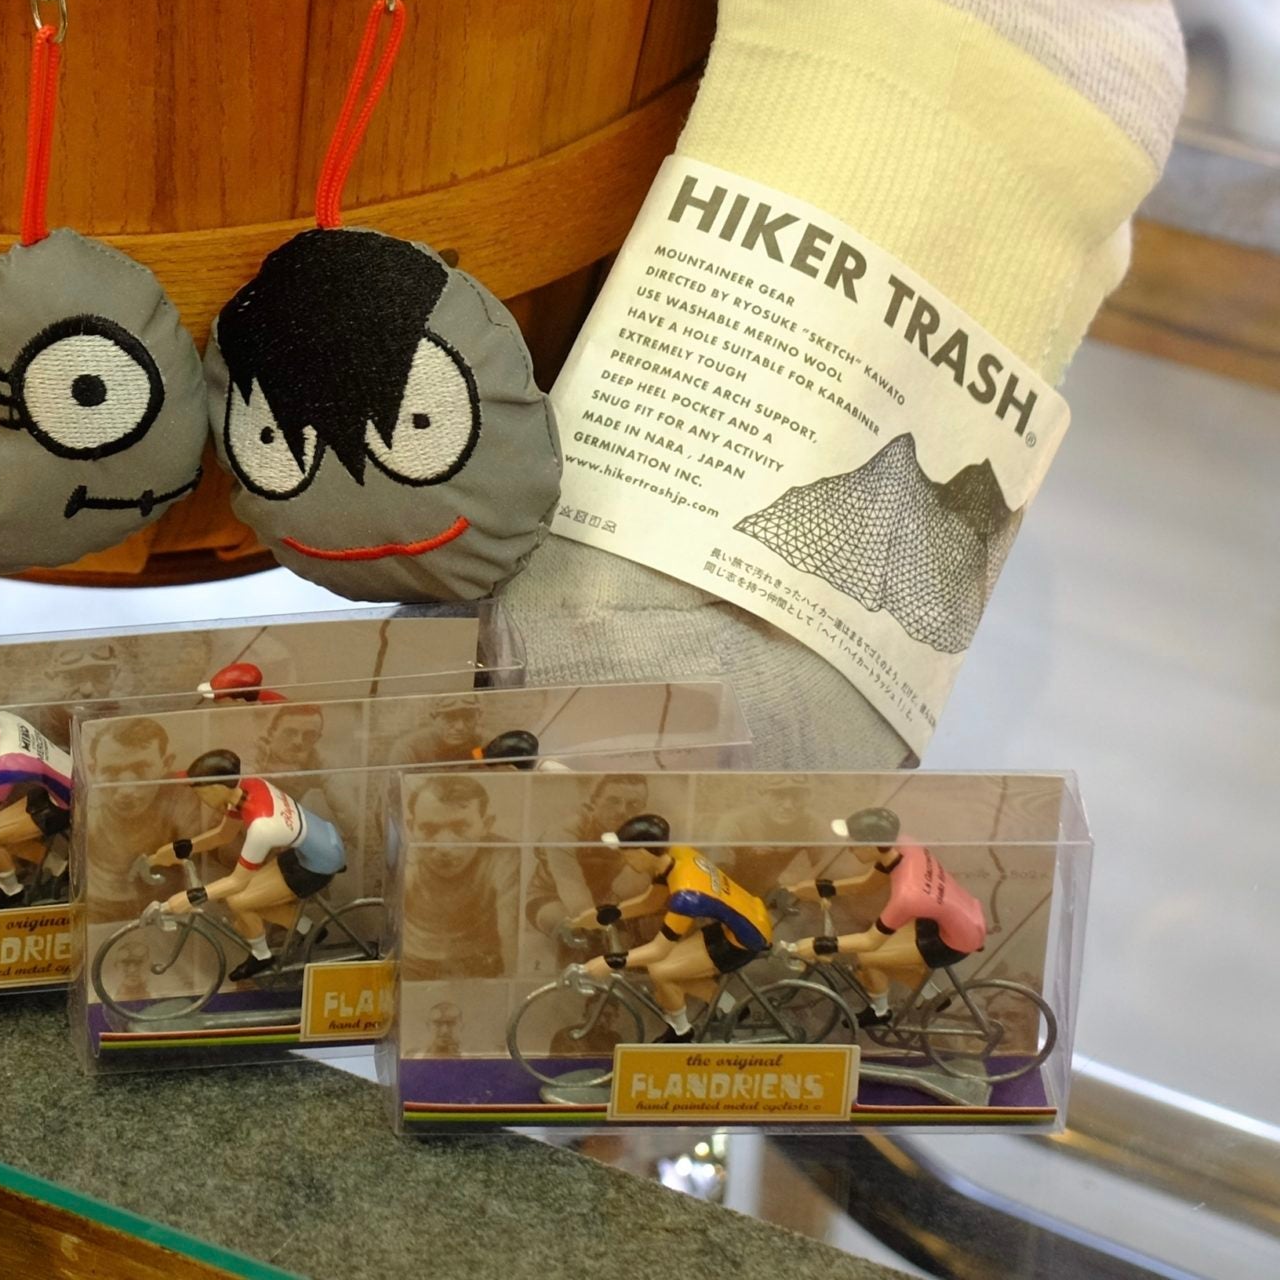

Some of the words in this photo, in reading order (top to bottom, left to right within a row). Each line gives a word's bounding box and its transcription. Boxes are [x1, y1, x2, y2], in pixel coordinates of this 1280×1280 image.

[667, 174, 868, 303] HIKER
[654, 244, 755, 289] MOUNTAINEER
[758, 284, 796, 308] GEAR
[618, 327, 694, 361] EXTREMELY
[697, 354, 748, 383] TOUGH
[636, 285, 662, 302] USE
[666, 295, 741, 331] WASHABLE
[743, 326, 799, 357] MERINO
[803, 353, 843, 383] WOOL
[645, 265, 706, 294] DIRECTED
[710, 288, 730, 302] BY
[732, 296, 798, 333] RYOSUKE
[863, 365, 906, 406] KAWATO
[610, 349, 710, 392] PERFORMANCE
[712, 386, 752, 409] ARCH
[754, 403, 818, 444] SUPPORT,
[627, 306, 665, 328] HAVE
[668, 321, 678, 333] A
[682, 326, 718, 346] HOLE
[721, 340, 785, 376] SUITABLE
[787, 370, 814, 391] FOR
[818, 386, 880, 437] KARABINER
[591, 389, 630, 410] SNUG
[634, 403, 655, 418] FIT
[656, 412, 685, 430] FOR
[687, 423, 720, 444] ANY
[722, 439, 784, 473] ACTIVITY
[600, 369, 634, 387] DEEP
[636, 381, 667, 400] HEEL
[671, 393, 726, 422] POCKET
[727, 416, 760, 438] AND
[762, 433, 773, 444] A
[573, 430, 671, 474] GERMINATION
[674, 468, 703, 488] INC.
[582, 409, 622, 431] MADE
[624, 423, 641, 438] IN
[644, 431, 685, 456] NARA
[697, 453, 746, 480] JAPAN
[565, 453, 720, 519] www.hikertrashjp.com
[14, 962, 53, 977] metal
[328, 1019, 360, 1030] hand
[630, 1072, 825, 1100] FLANDRIENS
[686, 1053, 711, 1067] the
[716, 1053, 784, 1070] original
[635, 1101, 670, 1111] hand
[672, 1101, 721, 1113] painted
[722, 1101, 760, 1111] metal
[762, 1101, 809, 1113] cyclists
